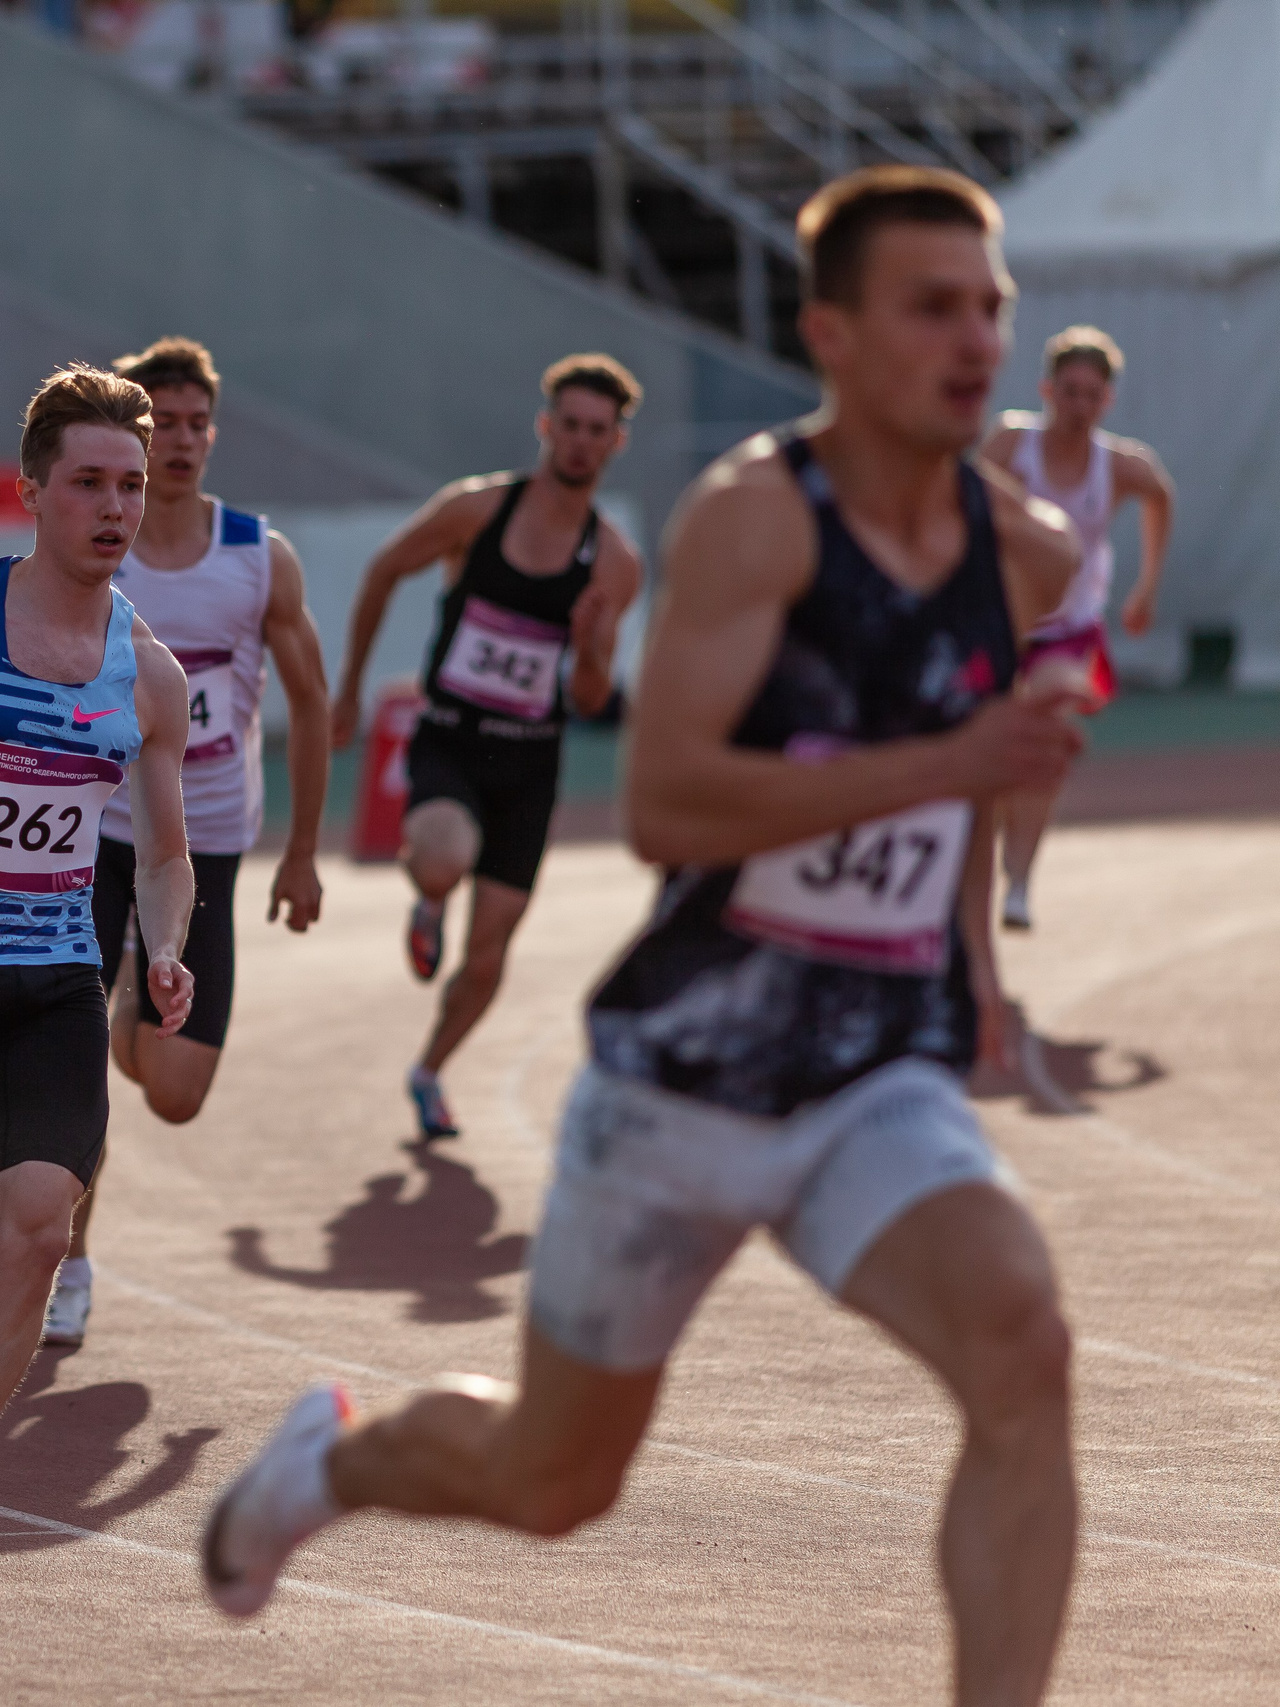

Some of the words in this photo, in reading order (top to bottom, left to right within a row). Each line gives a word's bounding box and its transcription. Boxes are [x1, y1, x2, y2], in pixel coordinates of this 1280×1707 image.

[469, 638, 543, 692] 342
[32, 768, 81, 780] ФЕДЕРАЛЬНОГО
[796, 828, 941, 908] 347
